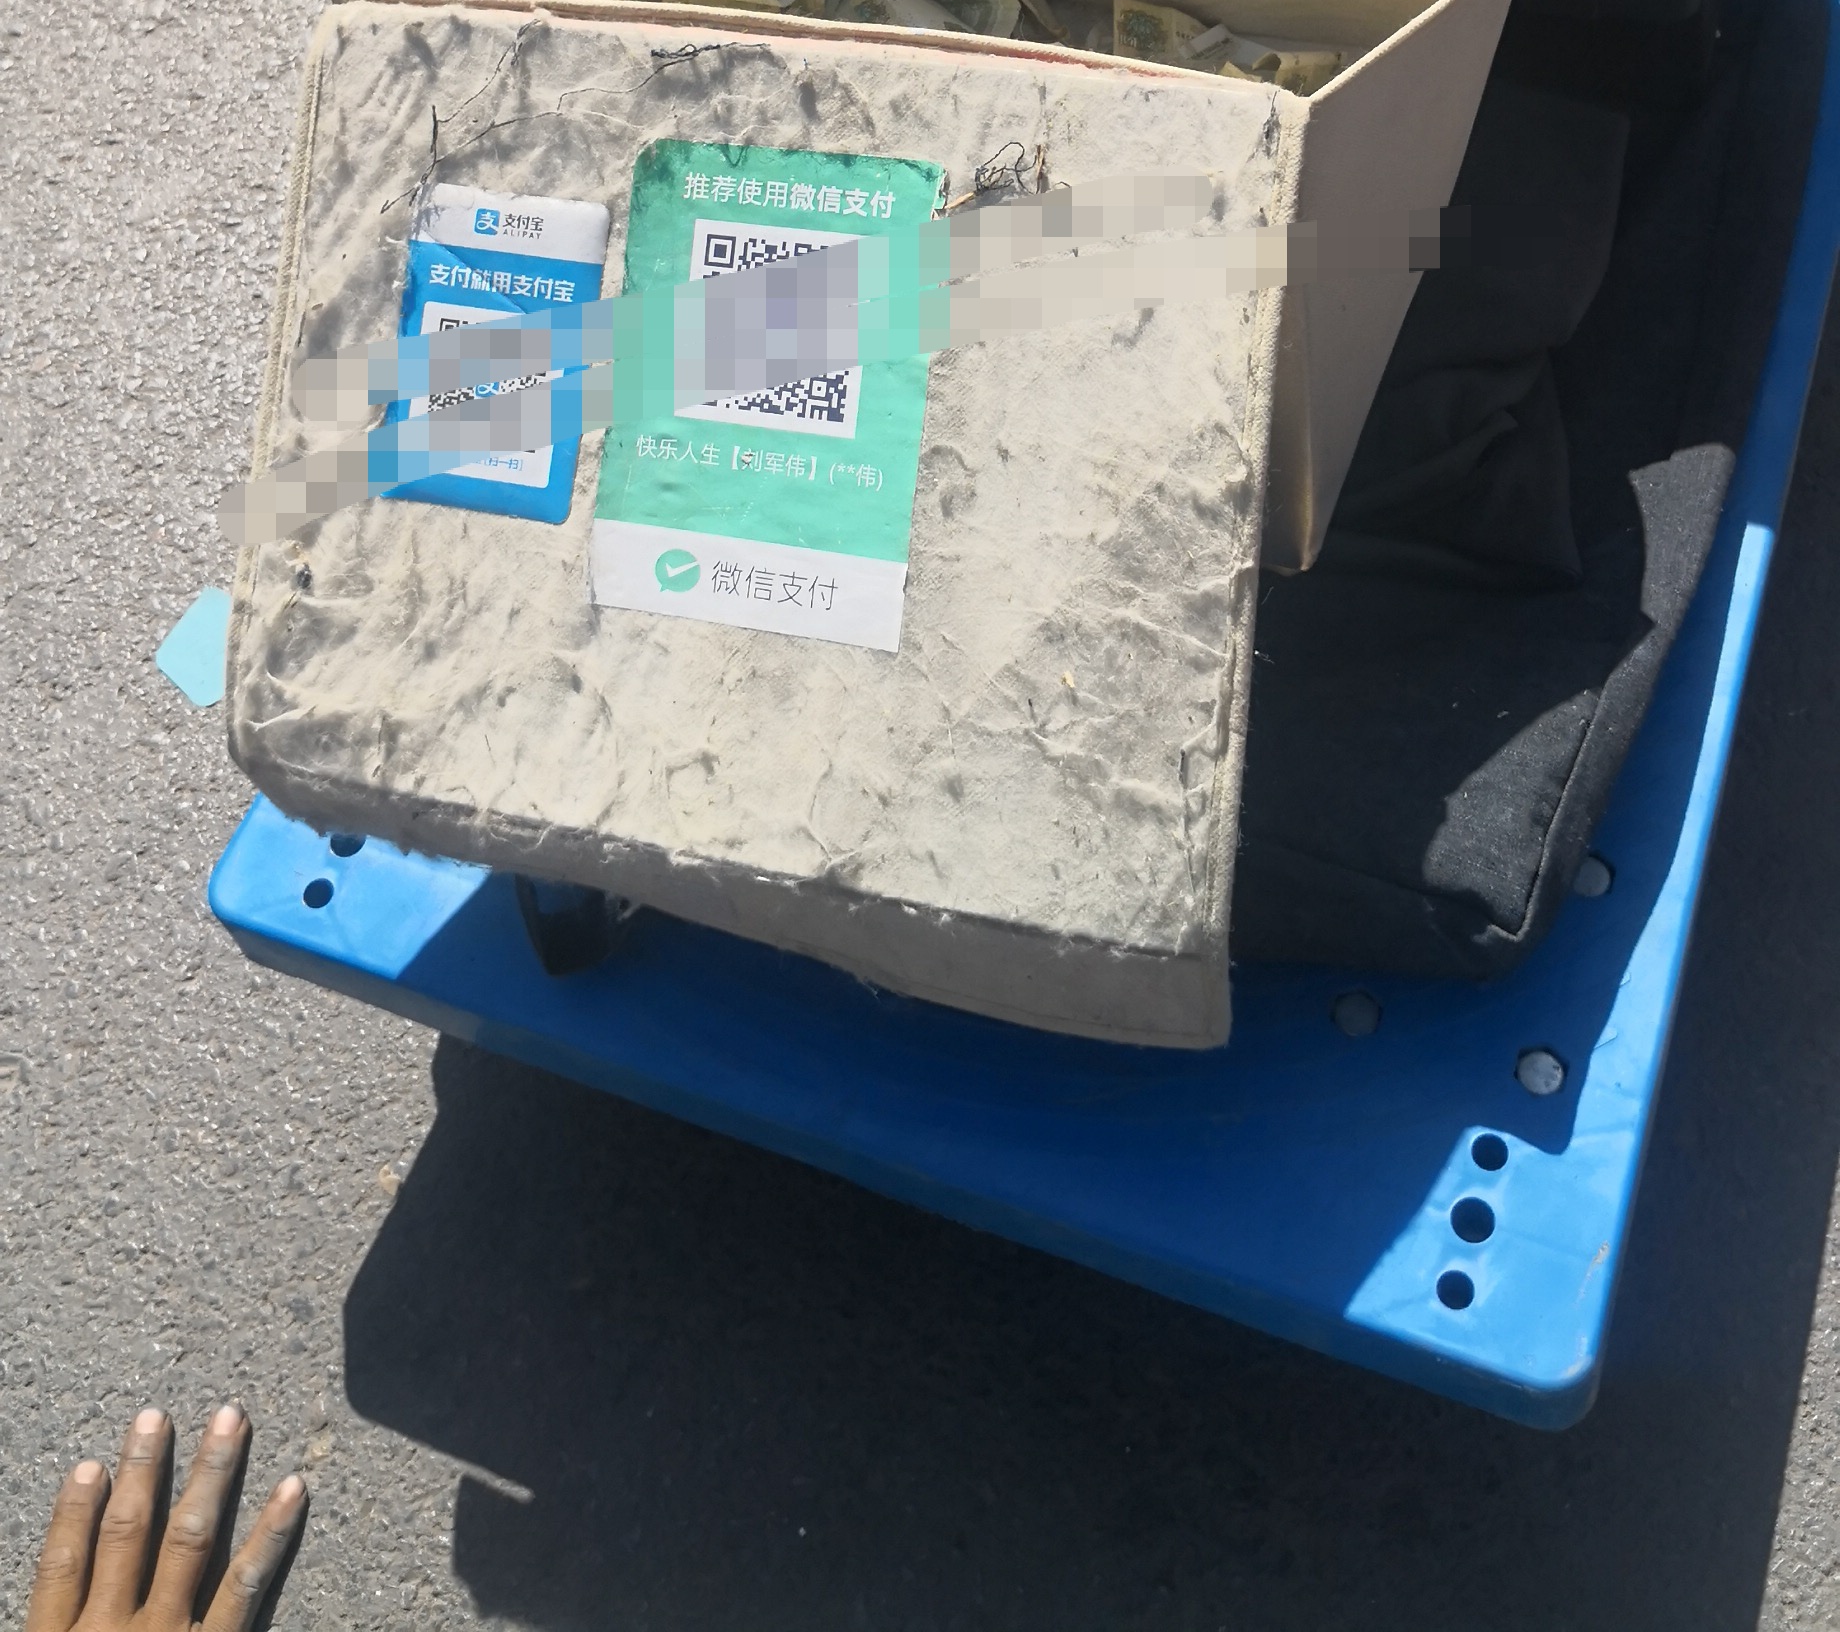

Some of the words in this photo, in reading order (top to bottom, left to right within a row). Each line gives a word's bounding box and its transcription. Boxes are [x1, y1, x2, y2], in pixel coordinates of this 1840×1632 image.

[682, 171, 896, 219] 推荐使用微信支付
[502, 213, 544, 231] 支付宝
[502, 228, 542, 239] ALIPAY
[429, 263, 576, 303] 支付就用支付宝
[711, 560, 839, 610] 微信支付
